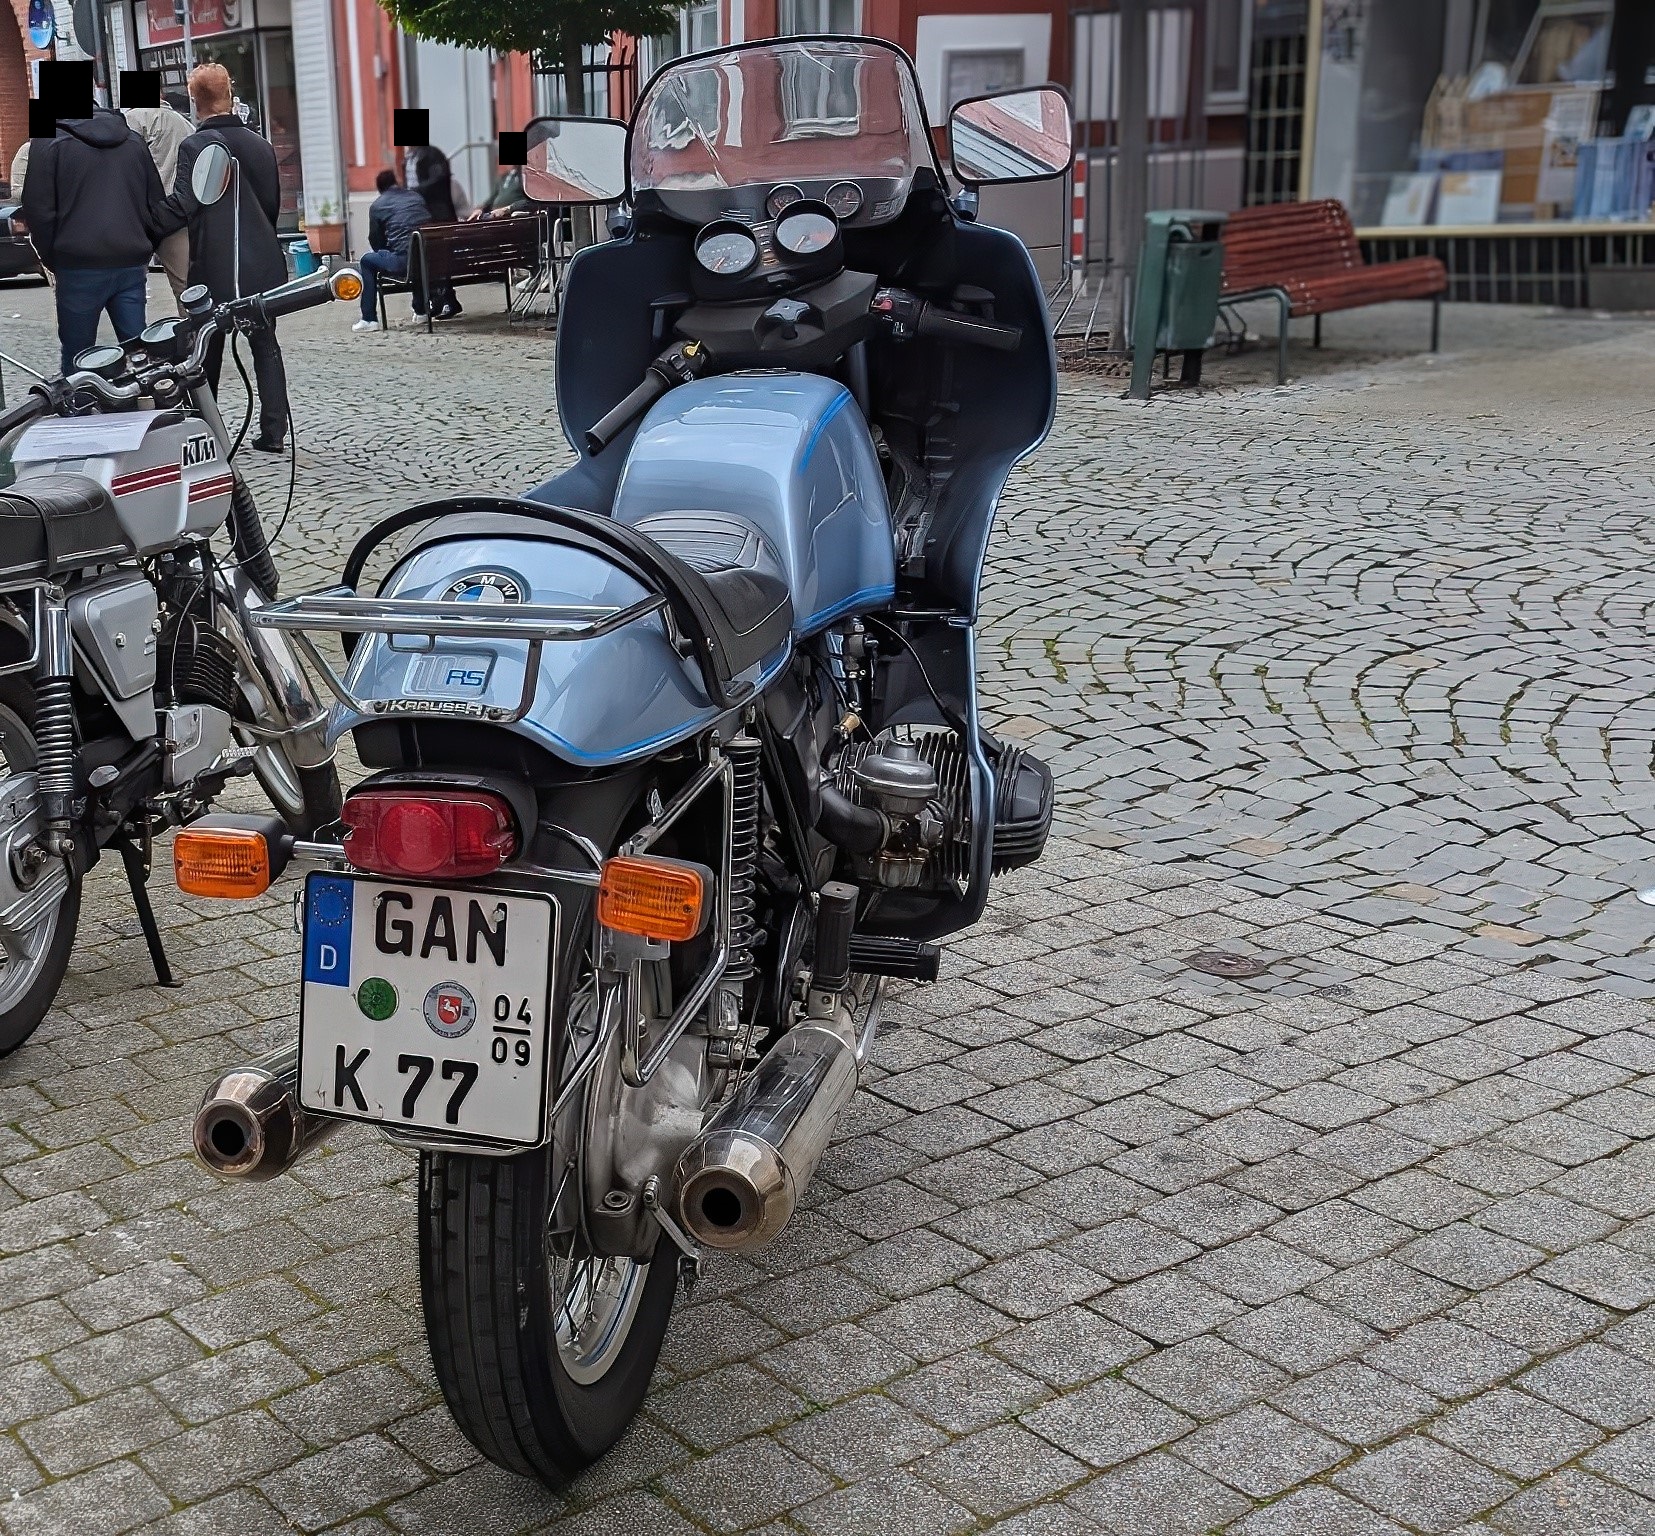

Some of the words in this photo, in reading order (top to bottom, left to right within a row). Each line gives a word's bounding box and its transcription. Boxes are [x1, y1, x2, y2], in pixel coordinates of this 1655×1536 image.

[182, 434, 217, 468] KTM
[453, 575, 518, 596] BMW
[446, 670, 486, 687] RS
[390, 700, 482, 716] KRAUSER
[375, 890, 508, 967] GAN
[320, 944, 338, 970] D
[494, 994, 532, 1025] 04
[492, 1036, 532, 1067] 09
[334, 1044, 371, 1112] K
[398, 1054, 479, 1125] 77
